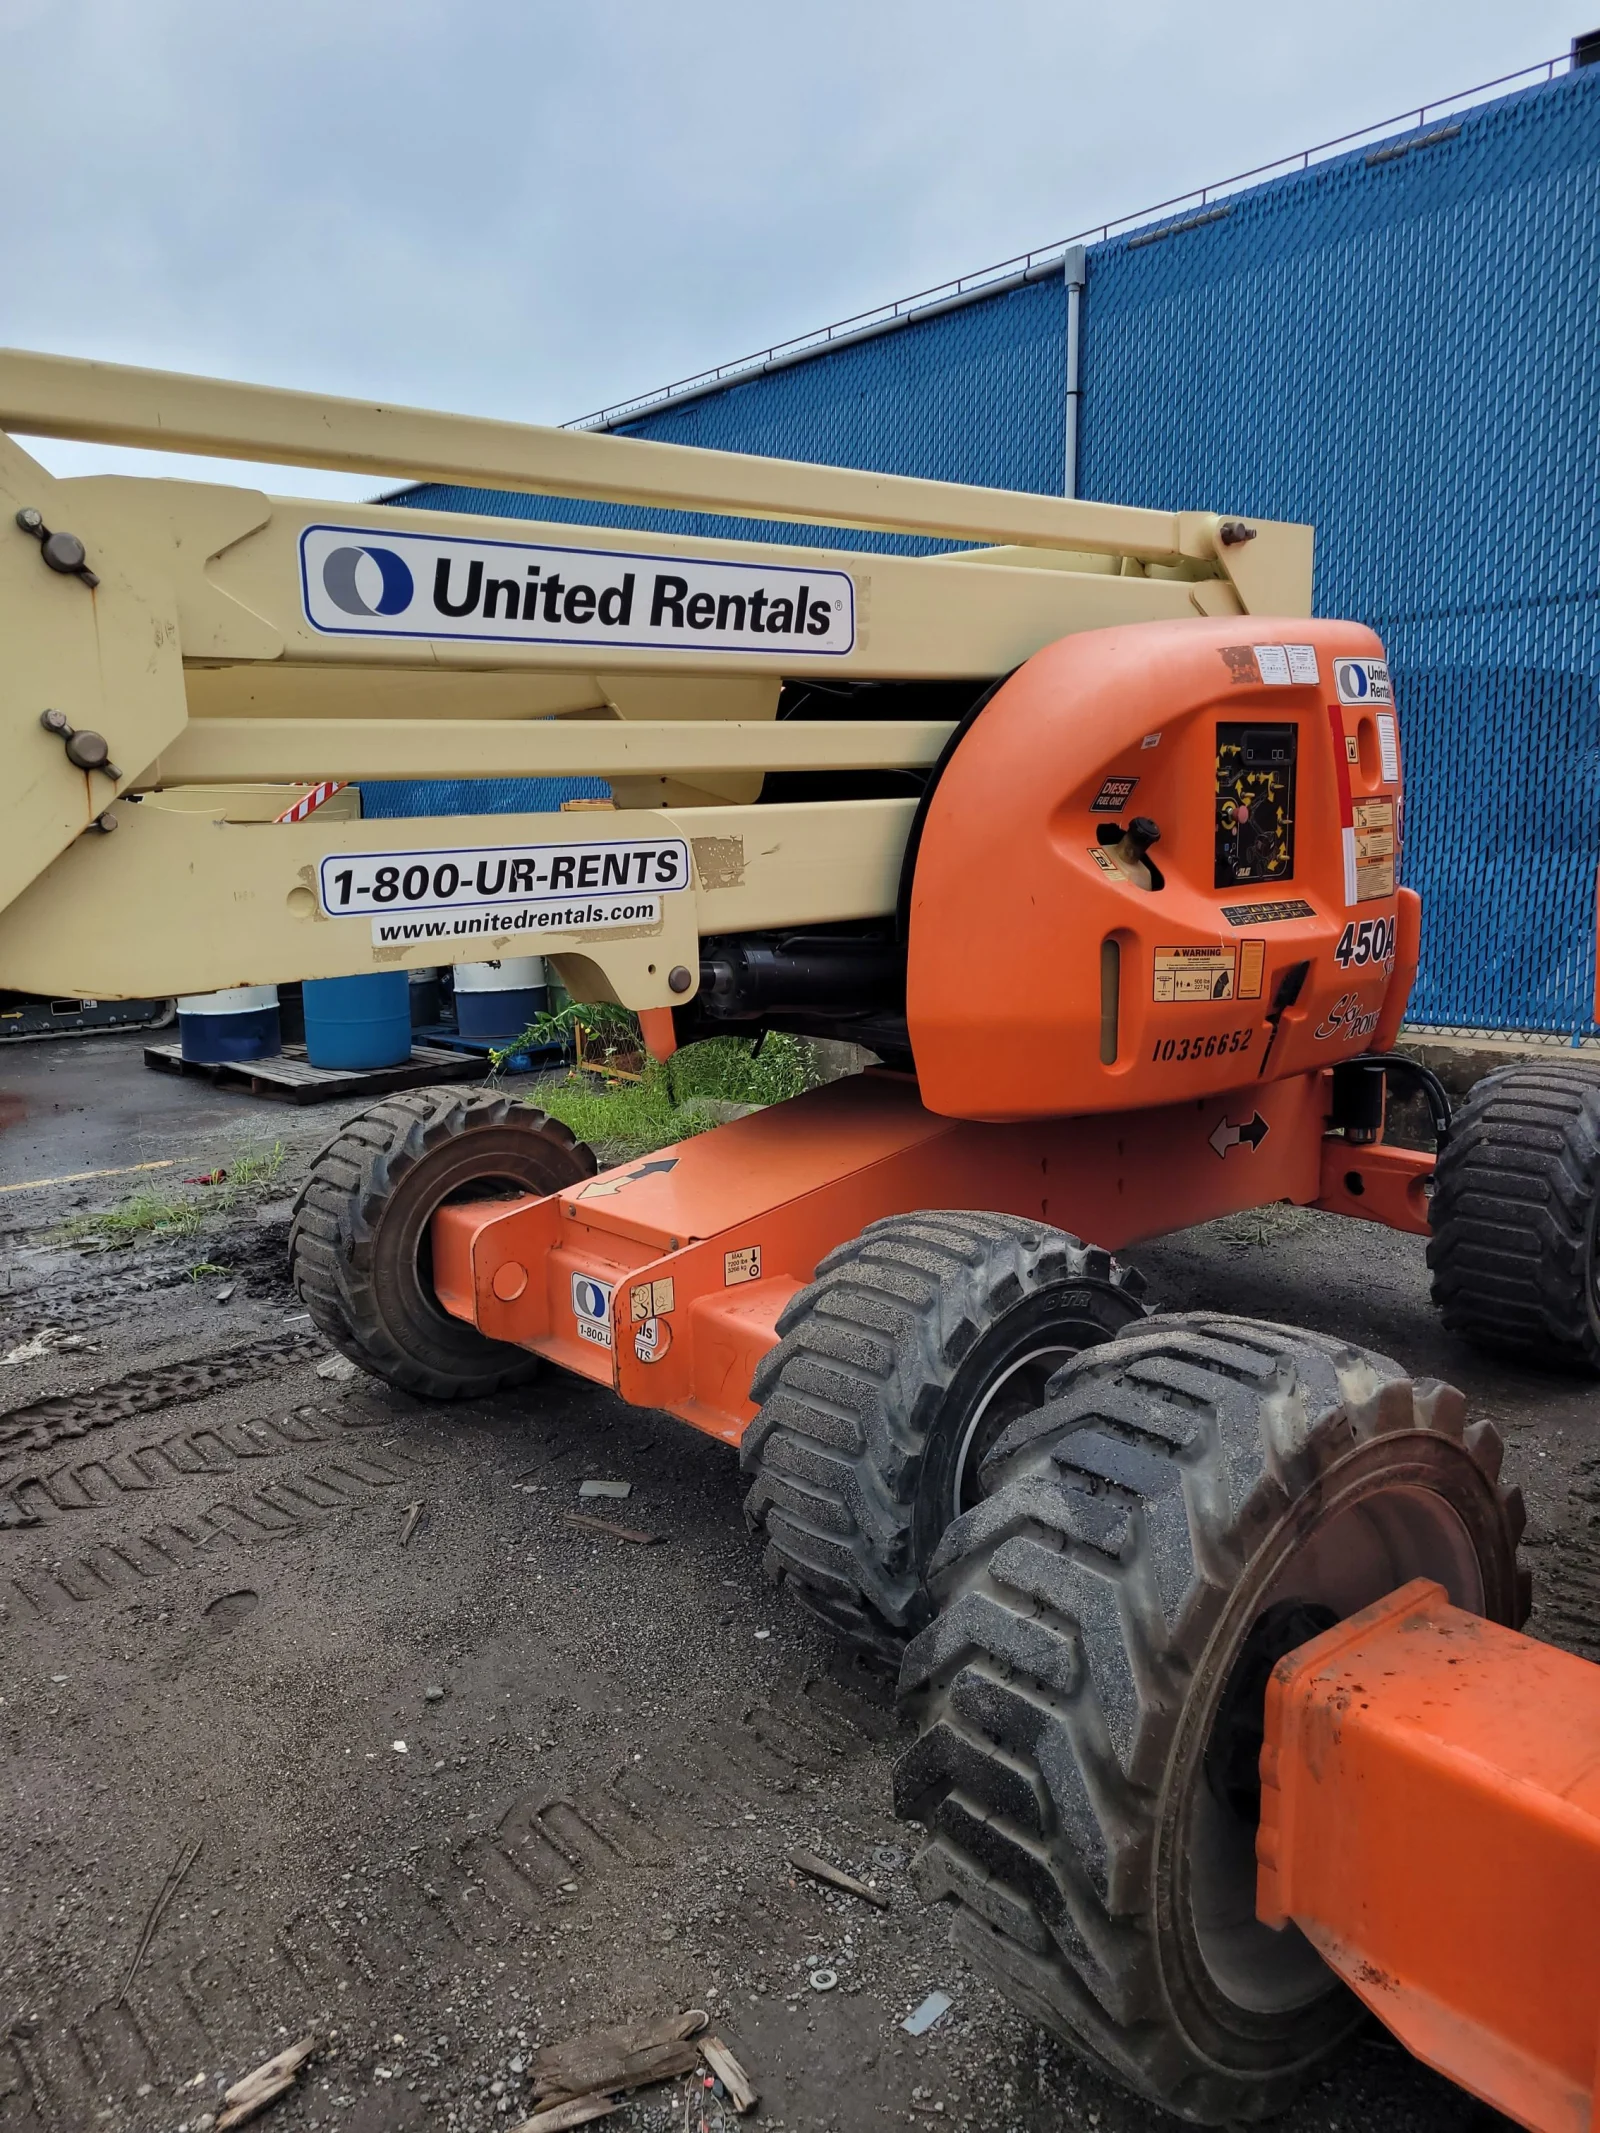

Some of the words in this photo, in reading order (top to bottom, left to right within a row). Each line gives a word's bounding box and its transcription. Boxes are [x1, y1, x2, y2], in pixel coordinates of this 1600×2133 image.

[433, 557, 635, 626] United
[1370, 682, 1391, 698] Renta
[1102, 782, 1132, 795] DIESEL
[1096, 796, 1111, 805] FUEL
[1109, 796, 1126, 806] ONLY
[334, 849, 679, 905] 1-800-UR-RENTS
[380, 903, 655, 941] www.unitedrentals.com
[1182, 948, 1222, 957] WARNING
[1152, 1028, 1253, 1061] 10356652
